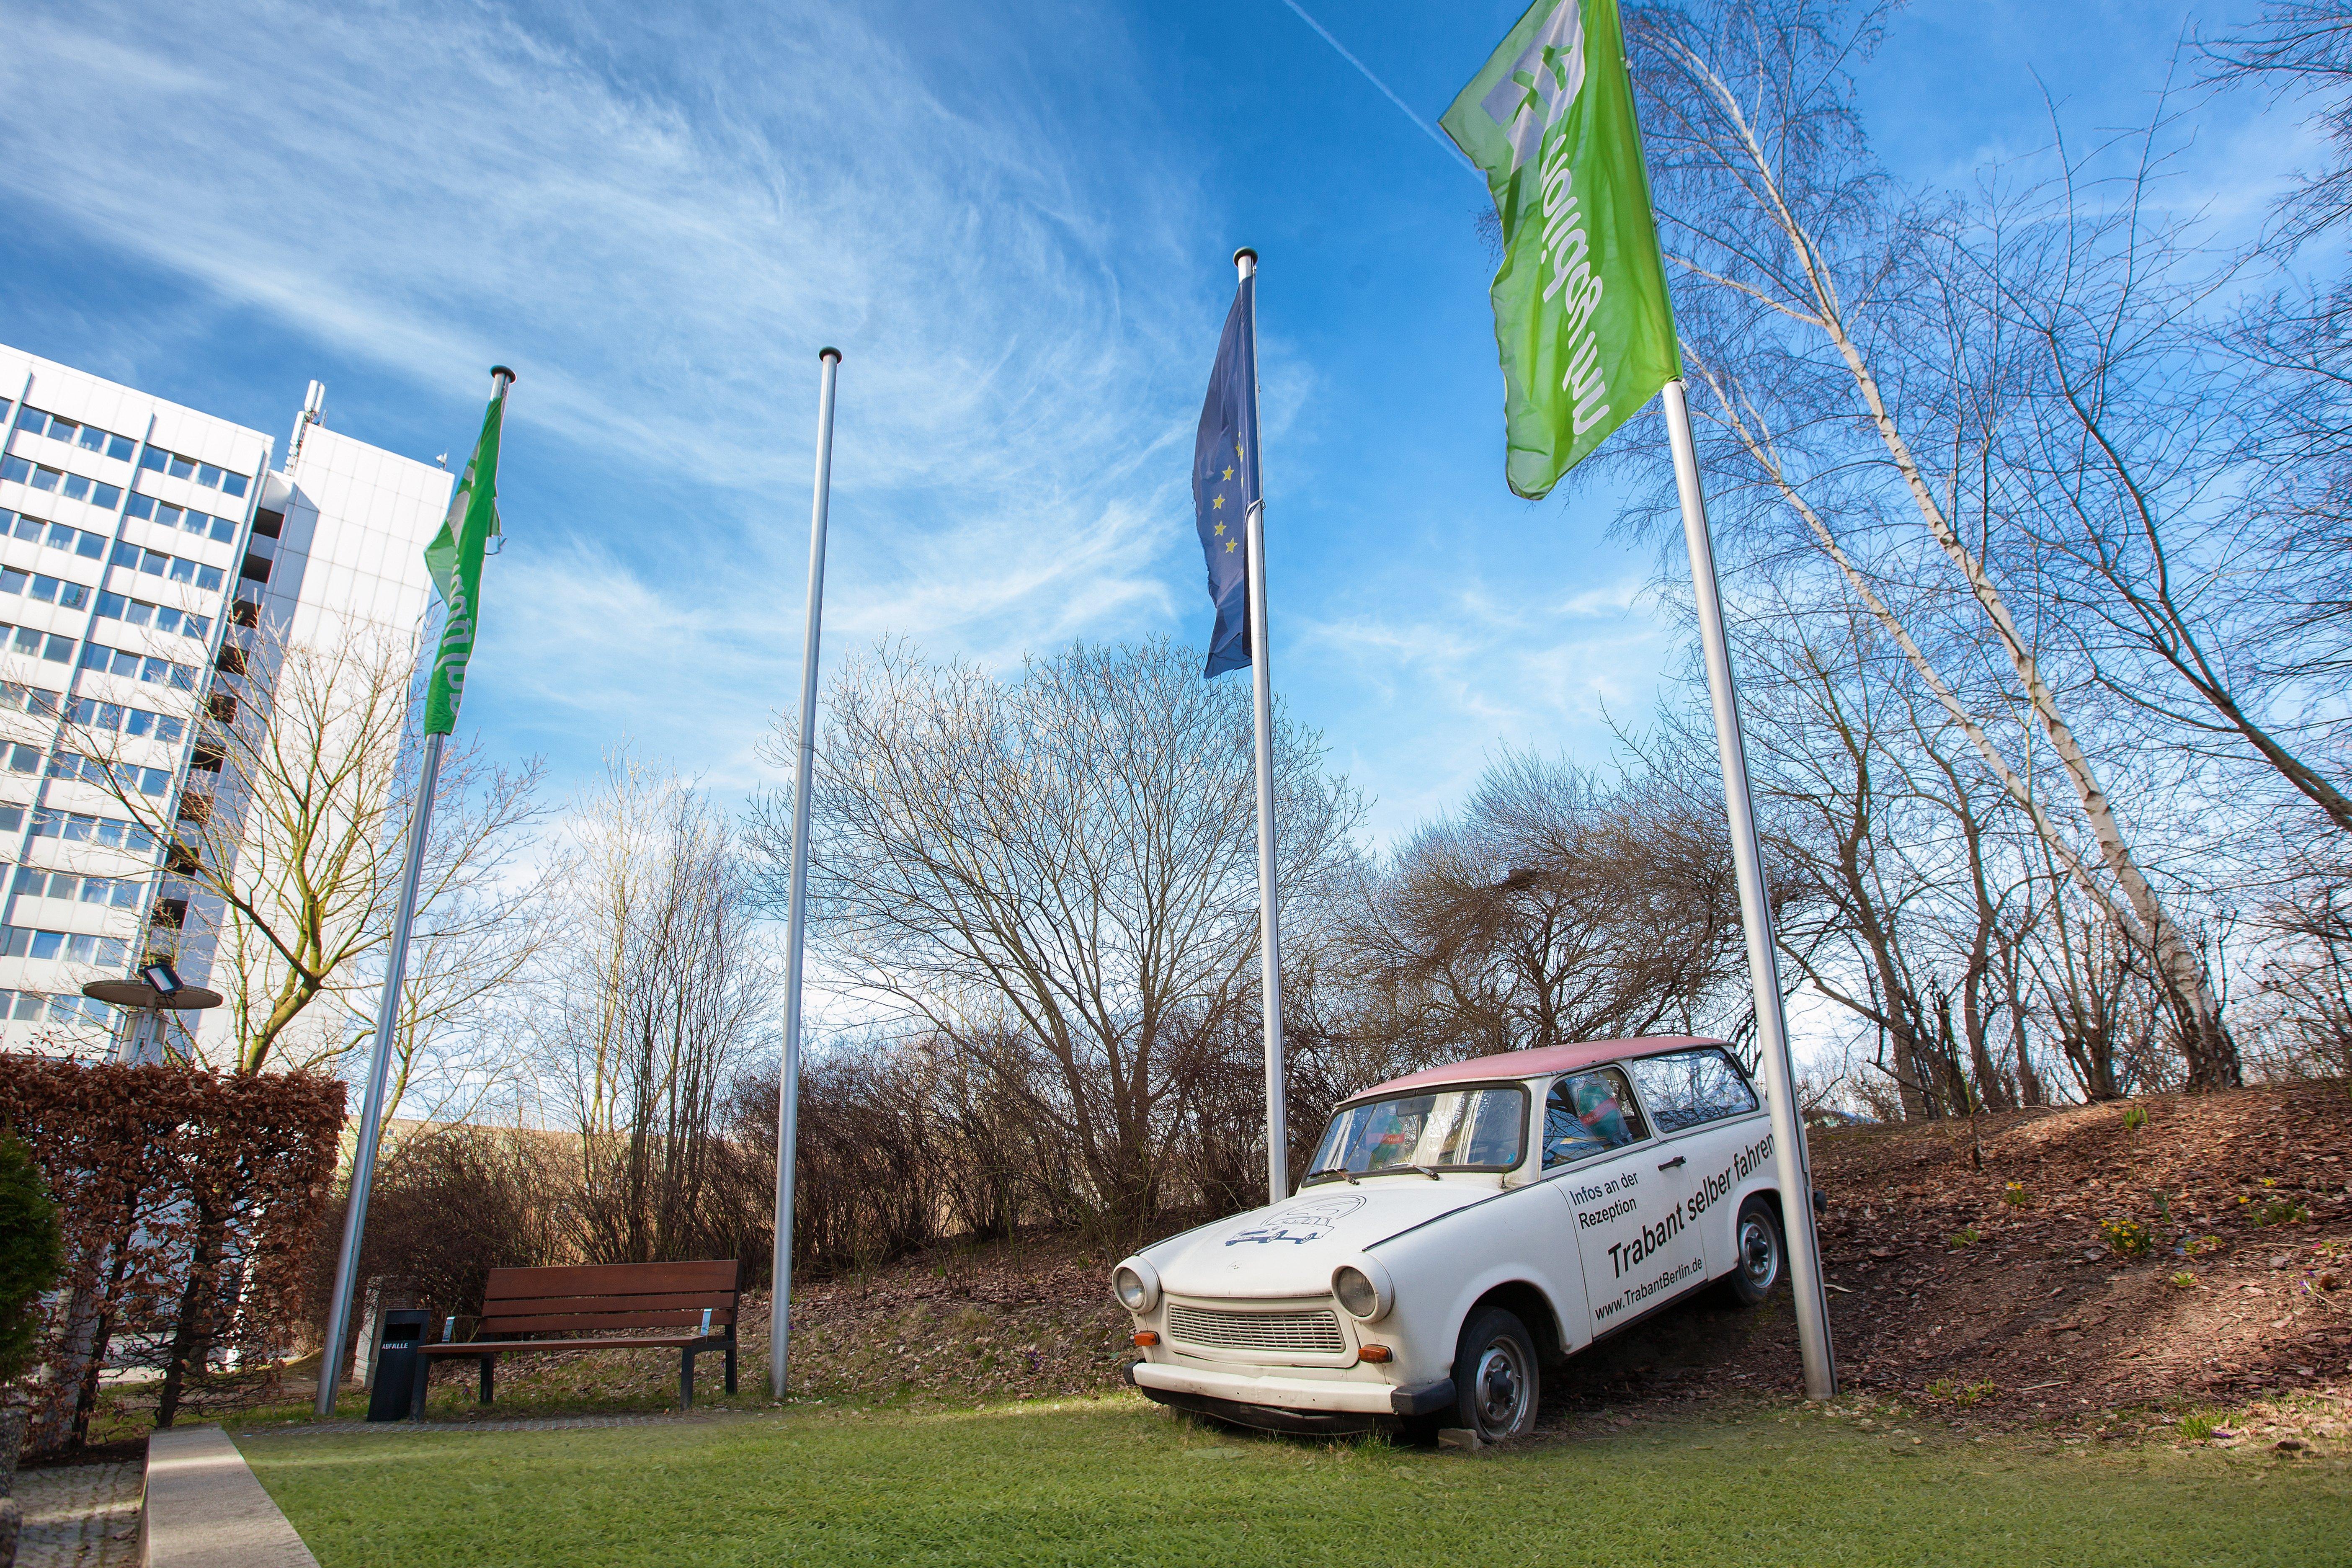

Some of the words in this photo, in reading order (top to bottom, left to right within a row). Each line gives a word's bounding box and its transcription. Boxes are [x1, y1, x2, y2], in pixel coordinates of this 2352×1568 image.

[1569, 1186, 1603, 1206] Infos
[1604, 1180, 1620, 1194] an
[1620, 1173, 1638, 1188] der
[1578, 1198, 1637, 1230] Rezeption
[1608, 1202, 1685, 1279] Trabant
[1687, 1168, 1730, 1221] selber
[1595, 1257, 1702, 1320] www.TrabantBerlin.de
